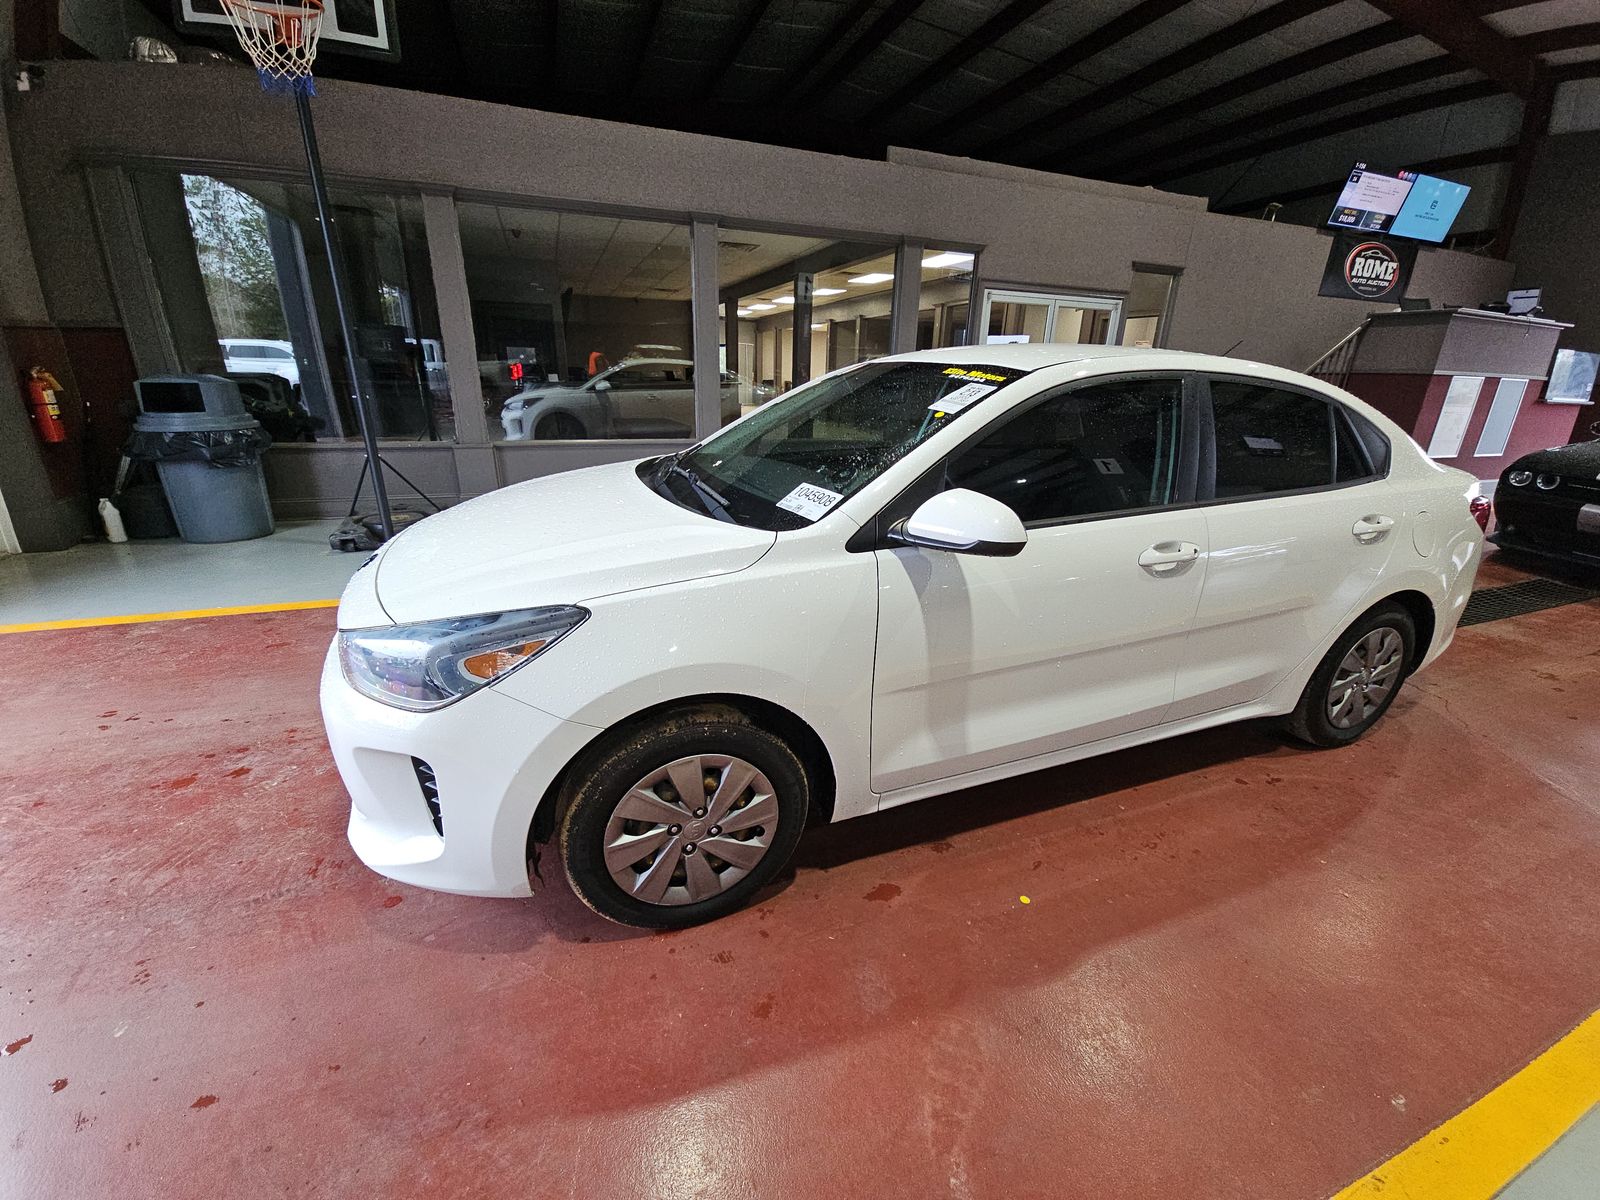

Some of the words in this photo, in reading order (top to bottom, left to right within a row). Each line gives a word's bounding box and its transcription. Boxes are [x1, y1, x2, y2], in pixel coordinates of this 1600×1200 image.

[1351, 257, 1399, 281] ROME
[1366, 279, 1390, 287] AUCTION
[966, 370, 1007, 382] Motors
[794, 486, 837, 507] 1045908
